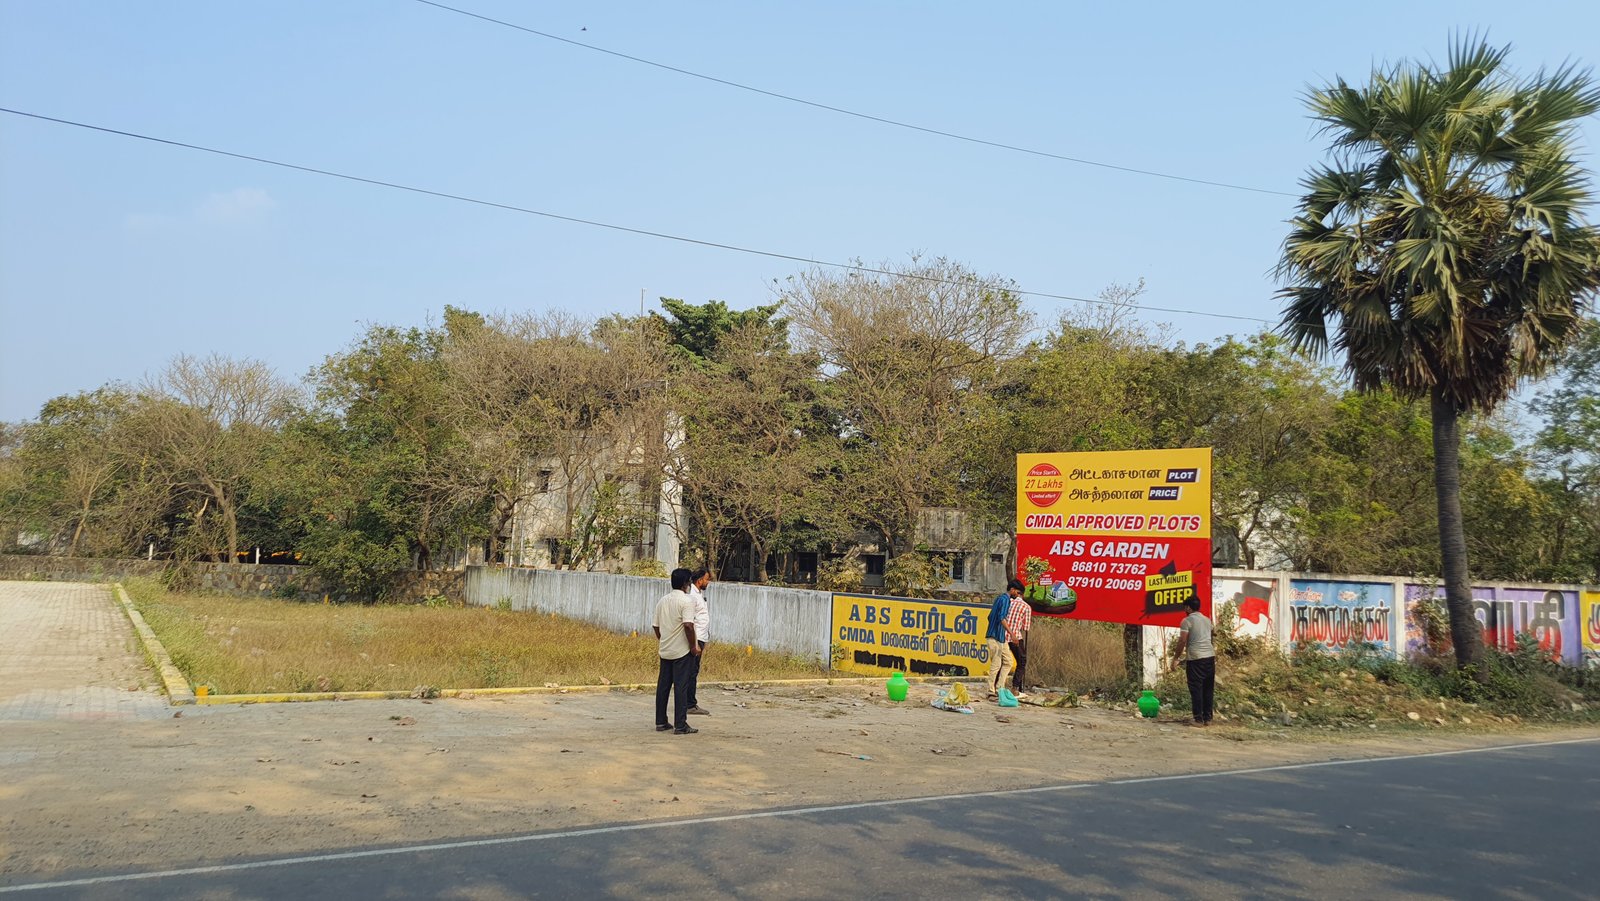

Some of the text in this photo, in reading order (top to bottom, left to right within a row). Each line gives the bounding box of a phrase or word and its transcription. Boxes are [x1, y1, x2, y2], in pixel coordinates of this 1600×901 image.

[1069, 468, 1194, 480] அட்டகாசமான PLOT
[1025, 479, 1063, 489] 27 Lakhs
[1068, 486, 1178, 503] அசத்தலான PRICE
[1025, 514, 1201, 532] CMDA APPROVED PLOTS
[1049, 540, 1170, 560] ABS GARDEN
[1071, 561, 1147, 575] 86810 73762
[1067, 576, 1103, 588] 97910
[1106, 577, 1143, 591] 20069
[1148, 574, 1188, 586] LAST MINUTE
[900, 606, 978, 636] கார்டன்
[839, 625, 876, 644] CMDA
[881, 630, 930, 653] மனைகள்
[933, 634, 989, 664] விற்பனைக்கு
